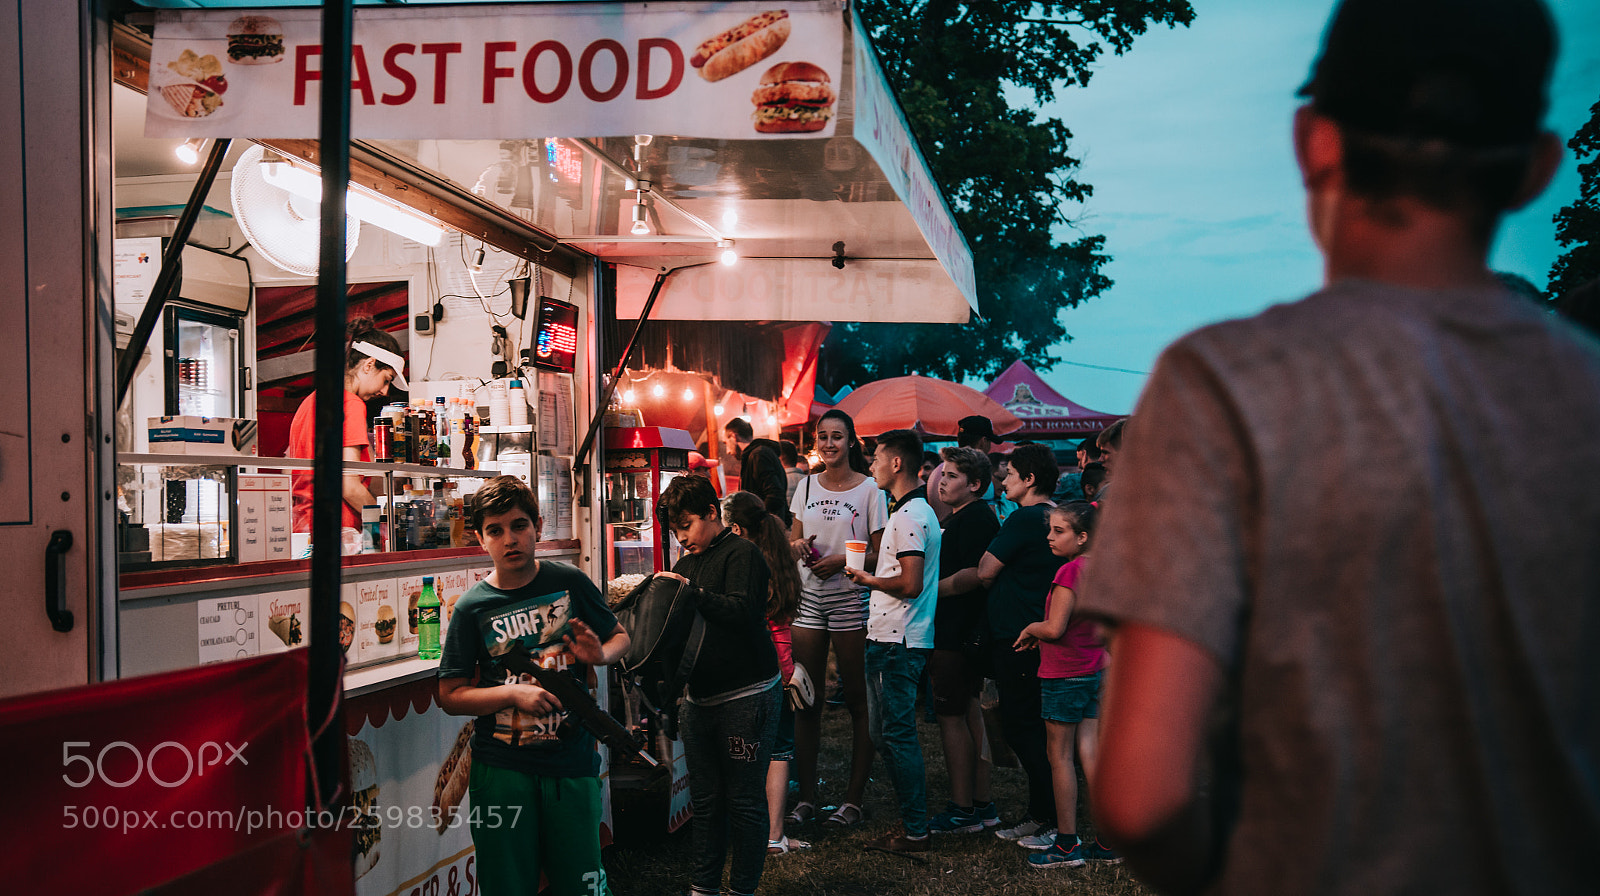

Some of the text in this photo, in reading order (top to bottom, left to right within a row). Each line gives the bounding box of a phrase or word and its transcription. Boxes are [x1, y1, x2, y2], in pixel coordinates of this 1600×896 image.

[293, 38, 686, 106] FAST FOOD
[807, 499, 840, 510] BEVERLY
[822, 508, 841, 516] GIRL
[445, 575, 455, 590] Hot
[268, 598, 301, 620] Shaorma
[491, 608, 540, 644] SURF
